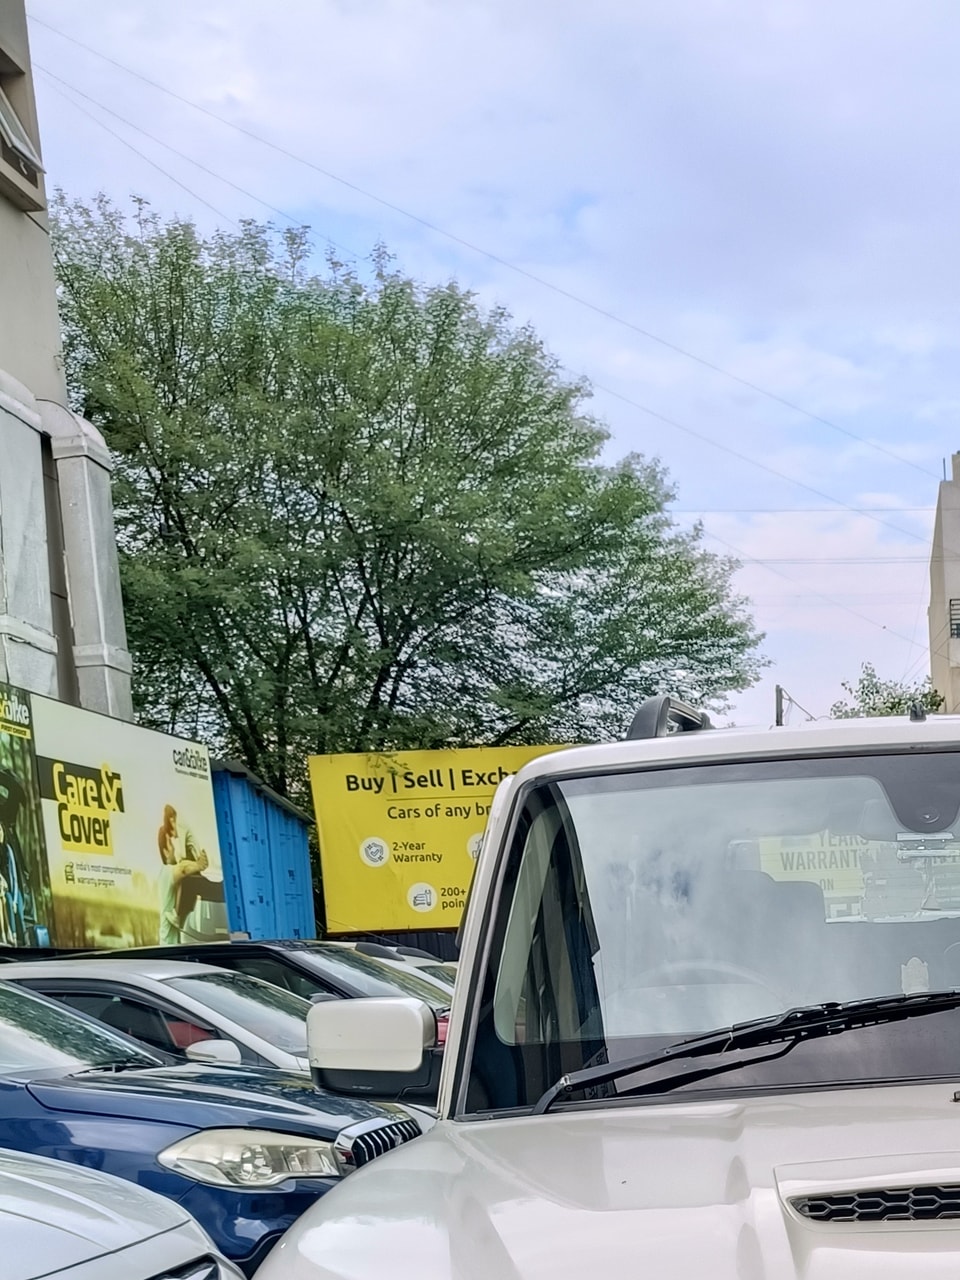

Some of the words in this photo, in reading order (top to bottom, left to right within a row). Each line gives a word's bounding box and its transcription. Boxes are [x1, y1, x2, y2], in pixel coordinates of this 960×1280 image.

[52, 762, 100, 809] Care
[346, 774, 385, 794] Buy
[404, 769, 444, 789] Sell
[461, 766, 519, 786] Exch
[387, 806, 421, 819] Cars
[425, 804, 442, 818] of
[445, 805, 472, 820] any
[58, 802, 110, 848] Cover
[392, 842, 426, 851] 2-Year
[392, 852, 443, 863] Warranty
[779, 849, 870, 872] WARRANT
[440, 887, 467, 897] 200+
